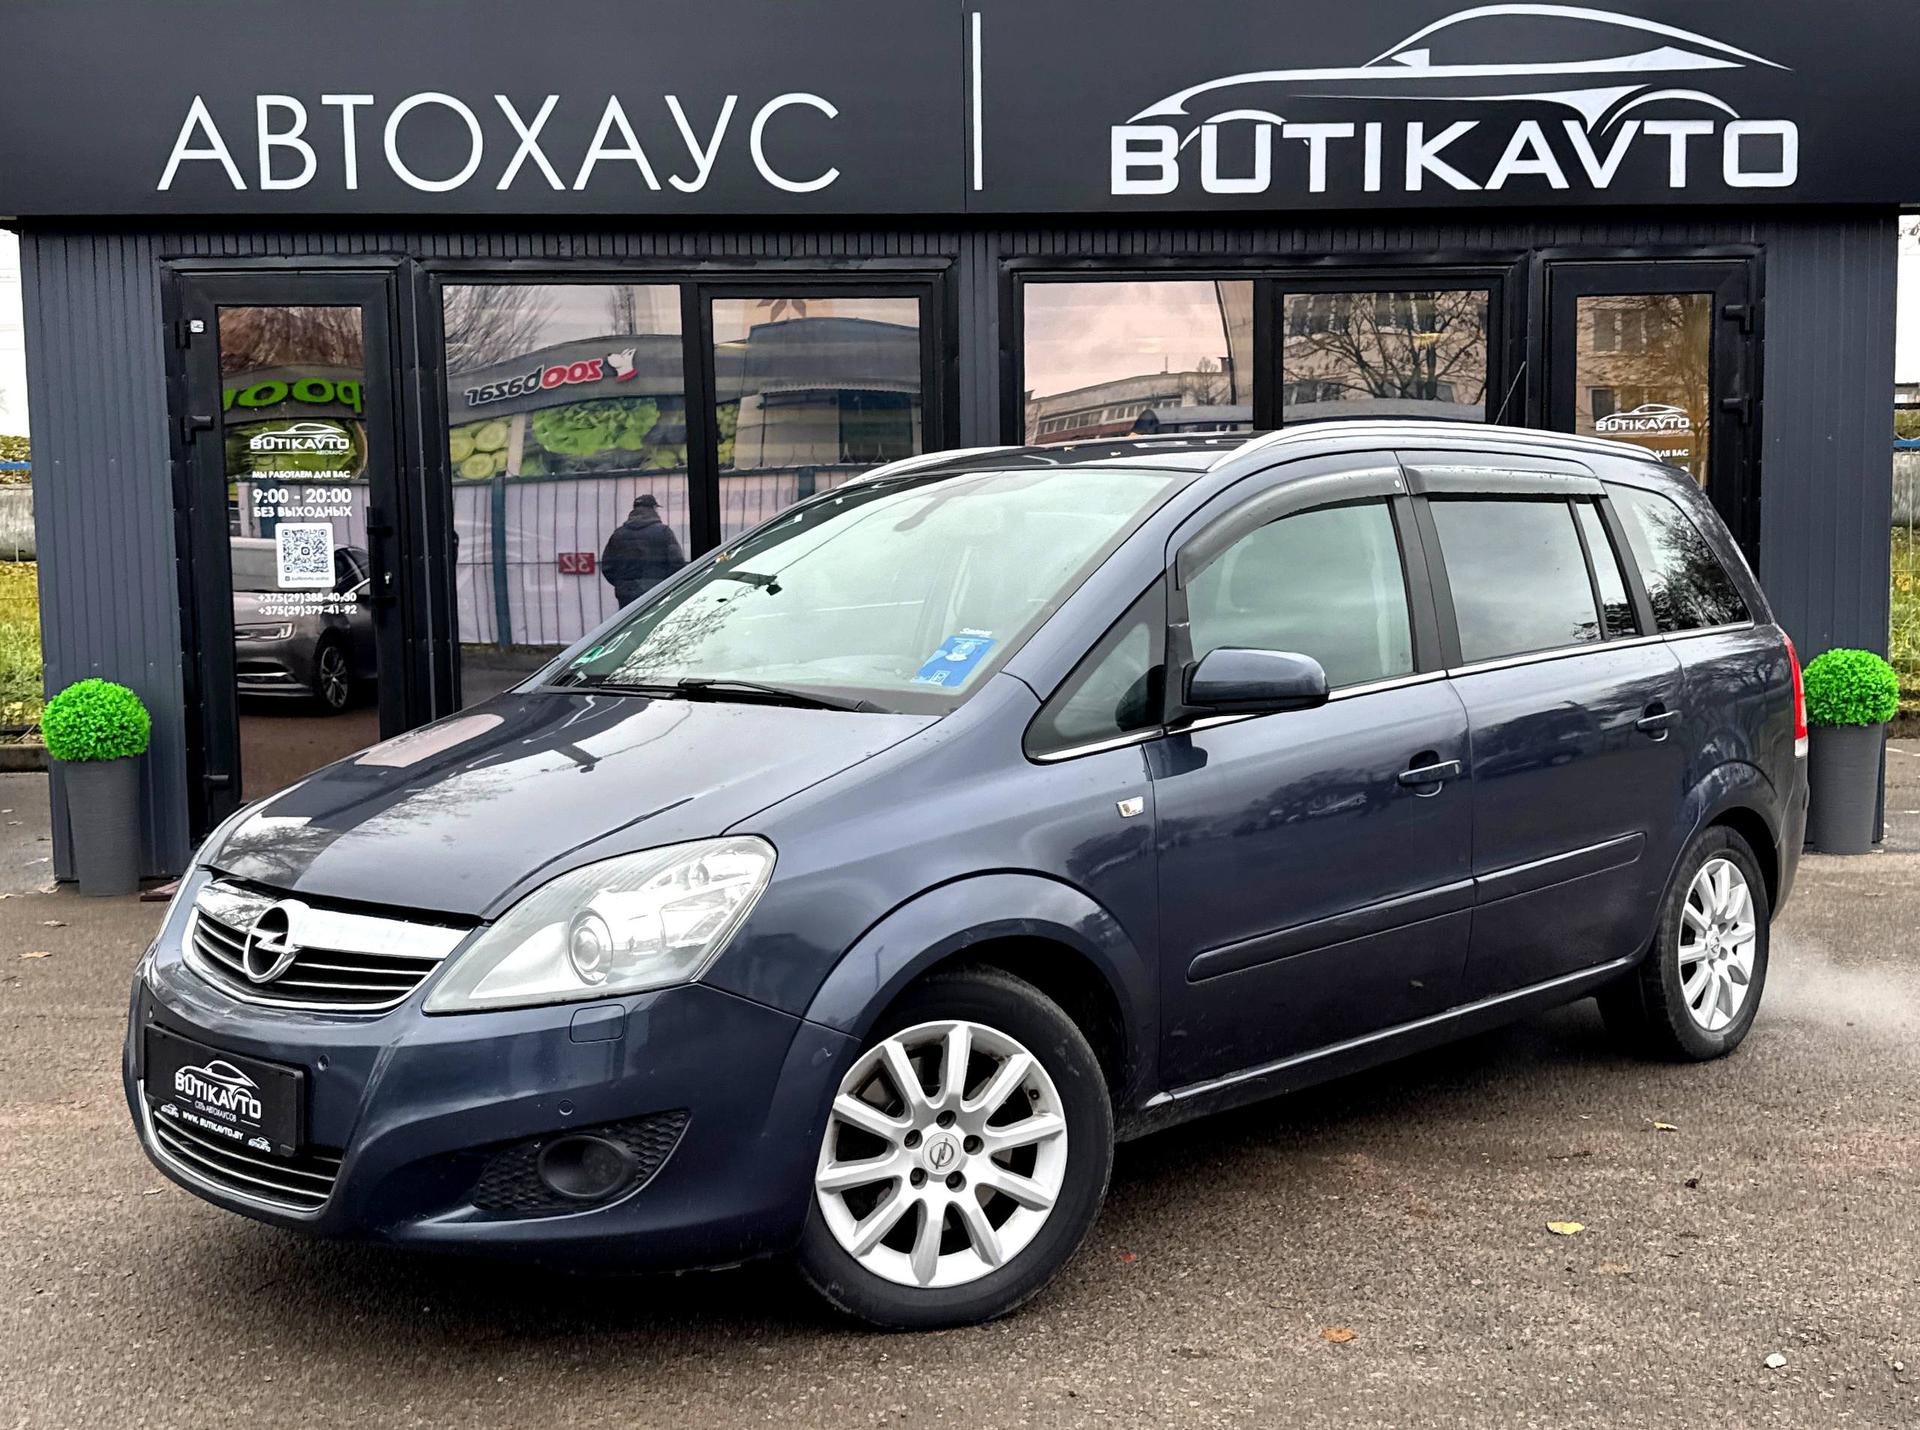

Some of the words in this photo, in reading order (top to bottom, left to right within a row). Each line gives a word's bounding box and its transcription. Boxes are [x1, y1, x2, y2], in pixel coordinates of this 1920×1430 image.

[157, 92, 840, 193] АВТОХАУС
[1110, 119, 1799, 195] BUTIKAVTO
[1595, 418, 1690, 431] BUTIKAVTO
[250, 437, 350, 450] BUTIKAVTO
[1672, 449, 1690, 457] ВАС
[252, 471, 267, 479] МЫ
[269, 471, 313, 479] РАБОТАЕМ
[314, 471, 331, 479] ДЛЯ
[332, 471, 351, 479] ВАС
[252, 488, 289, 504] 9:00
[305, 488, 353, 504] 20:00
[253, 506, 275, 518] БЕЗ
[277, 506, 353, 519] ВЫХОДНЫХ
[175, 1072, 262, 1119] BUTIKAVTO
